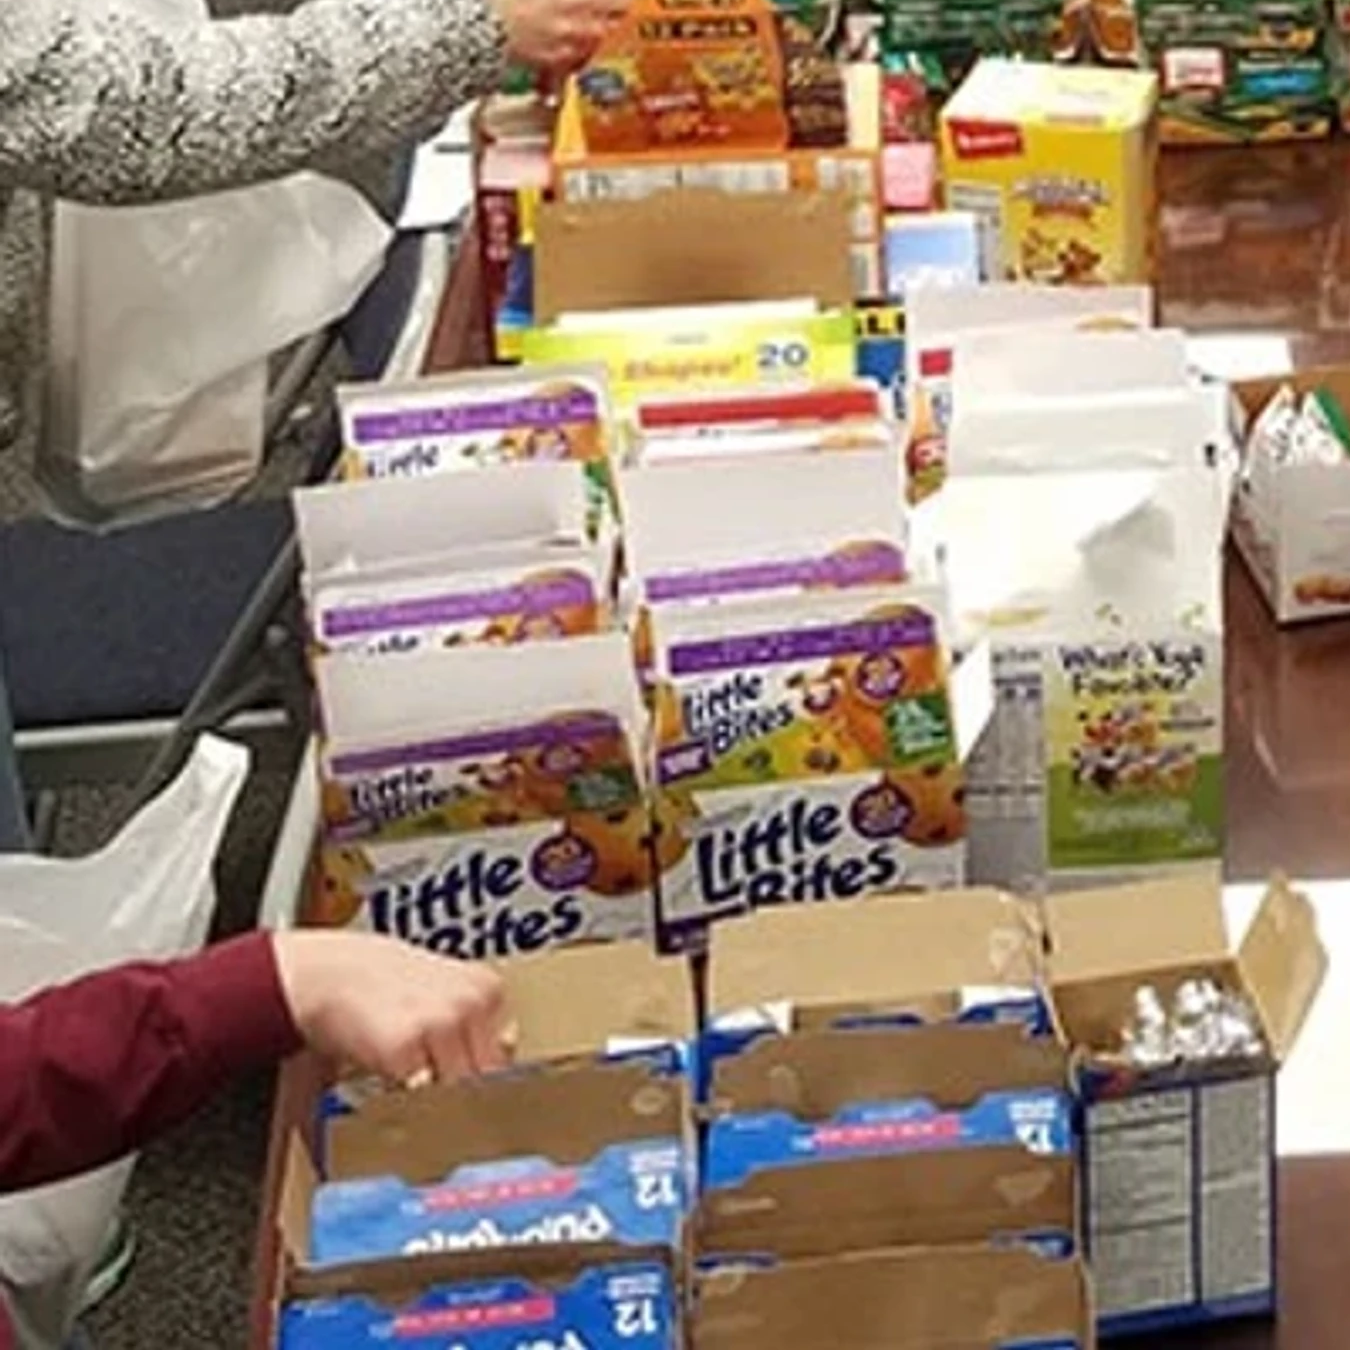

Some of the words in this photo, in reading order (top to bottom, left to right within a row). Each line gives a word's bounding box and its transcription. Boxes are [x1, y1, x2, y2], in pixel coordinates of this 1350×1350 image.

[757, 342, 809, 368] 20
[697, 798, 842, 905] Little
[634, 1173, 678, 1208] 12
[613, 1300, 658, 1338] 12
